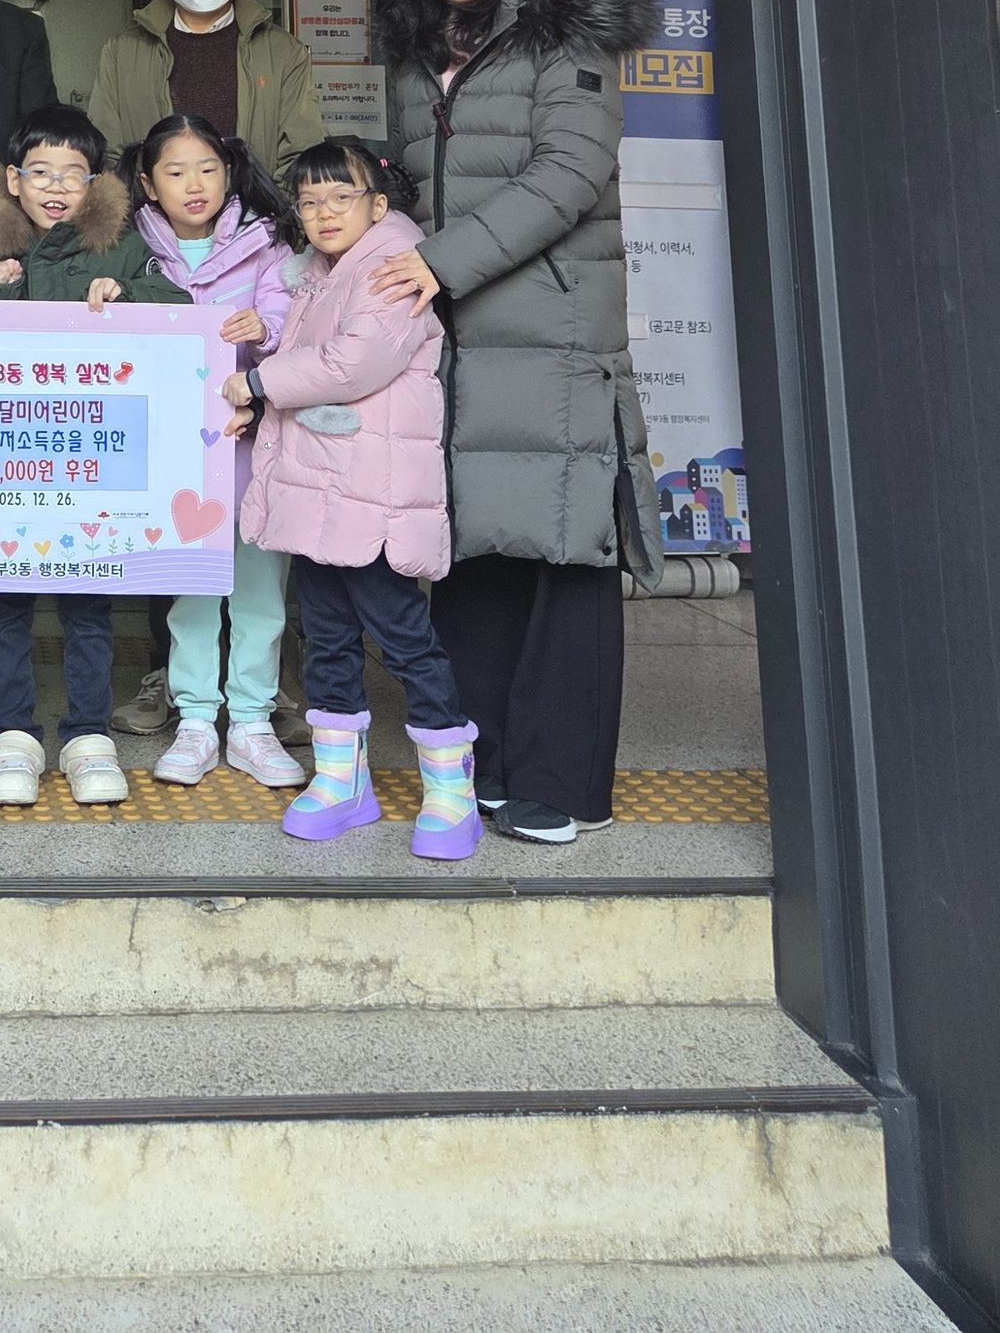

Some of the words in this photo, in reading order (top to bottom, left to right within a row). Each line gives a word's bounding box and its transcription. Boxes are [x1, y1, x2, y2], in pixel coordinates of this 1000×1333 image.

[322, 5, 342, 13] 우리는
[662, 8, 711, 38] 통장
[624, 240, 657, 255] 신청서,
[660, 242, 695, 256] 이력서,
[631, 259, 642, 273] 등
[649, 320, 685, 334] (공고문
[687, 320, 712, 334] 참조)
[32, 362, 67, 384] 행복
[76, 362, 111, 384] 실천
[0, 430, 83, 453] 저소득층을
[93, 430, 126, 452] 위한
[65, 459, 99, 483] 후원
[33, 492, 49, 506] 12.
[56, 492, 76, 506] 26.
[38, 562, 124, 578] 행정복지센터
